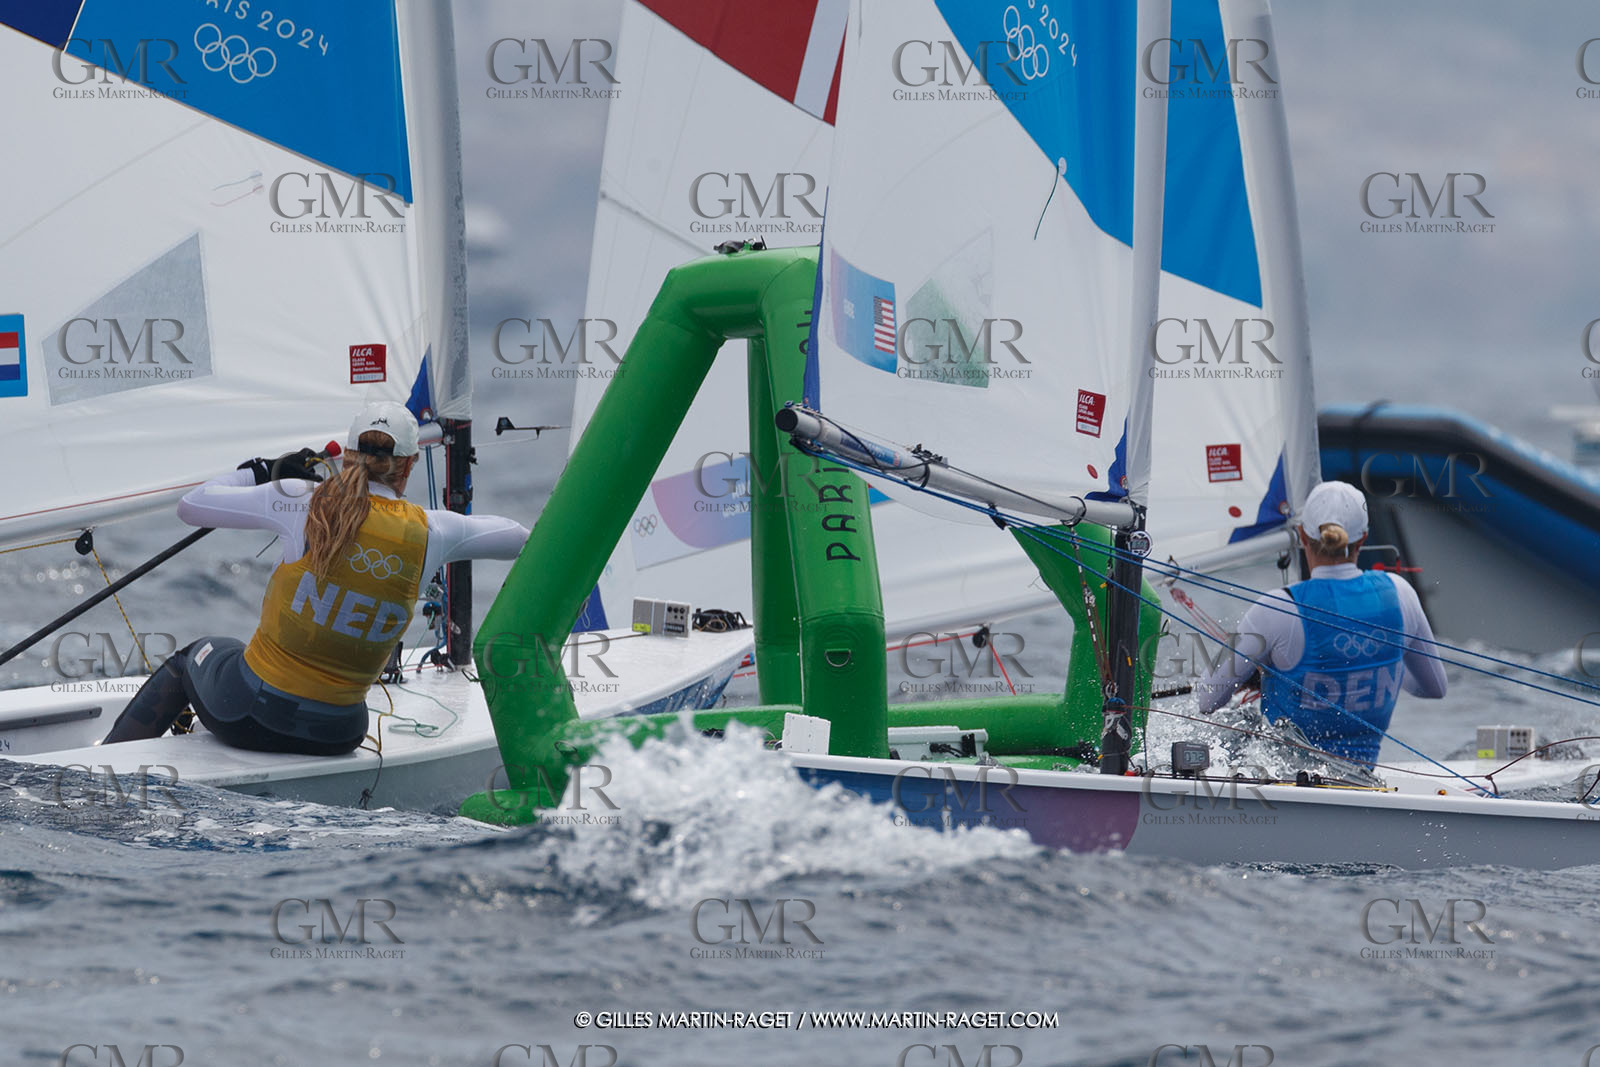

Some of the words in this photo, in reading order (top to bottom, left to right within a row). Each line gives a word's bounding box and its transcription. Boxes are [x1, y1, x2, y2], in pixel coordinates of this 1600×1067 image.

[257, 10, 329, 56] 2024
[1039, 4, 1077, 67] 2024
[352, 347, 372, 357] ILCA
[1080, 394, 1094, 405] ILCA
[1209, 447, 1228, 457] ILCA
[816, 466, 861, 561] PARI
[290, 571, 408, 642] NED
[1300, 660, 1403, 712] DEN
